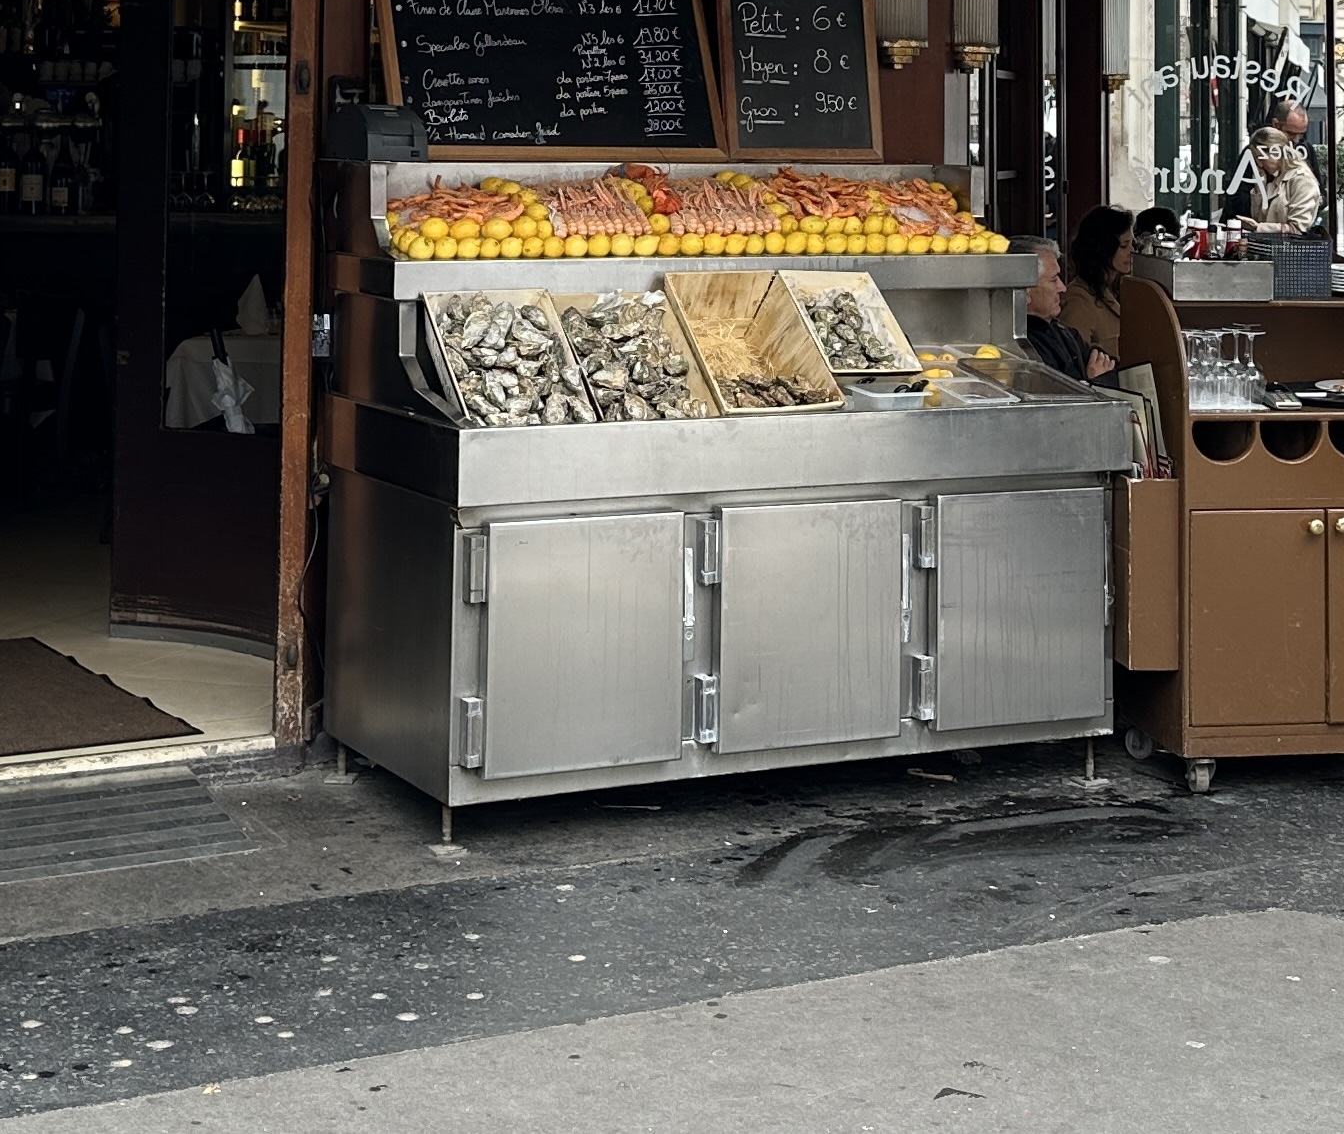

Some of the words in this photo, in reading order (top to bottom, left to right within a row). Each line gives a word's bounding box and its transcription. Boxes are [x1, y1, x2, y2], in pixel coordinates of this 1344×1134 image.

[737, 1, 788, 34] Petit
[812, 5, 831, 31] 6
[618, 55, 626, 66] 6
[739, 46, 788, 82] Moyen
[813, 48, 832, 73] 8
[740, 96, 778, 133] Gros
